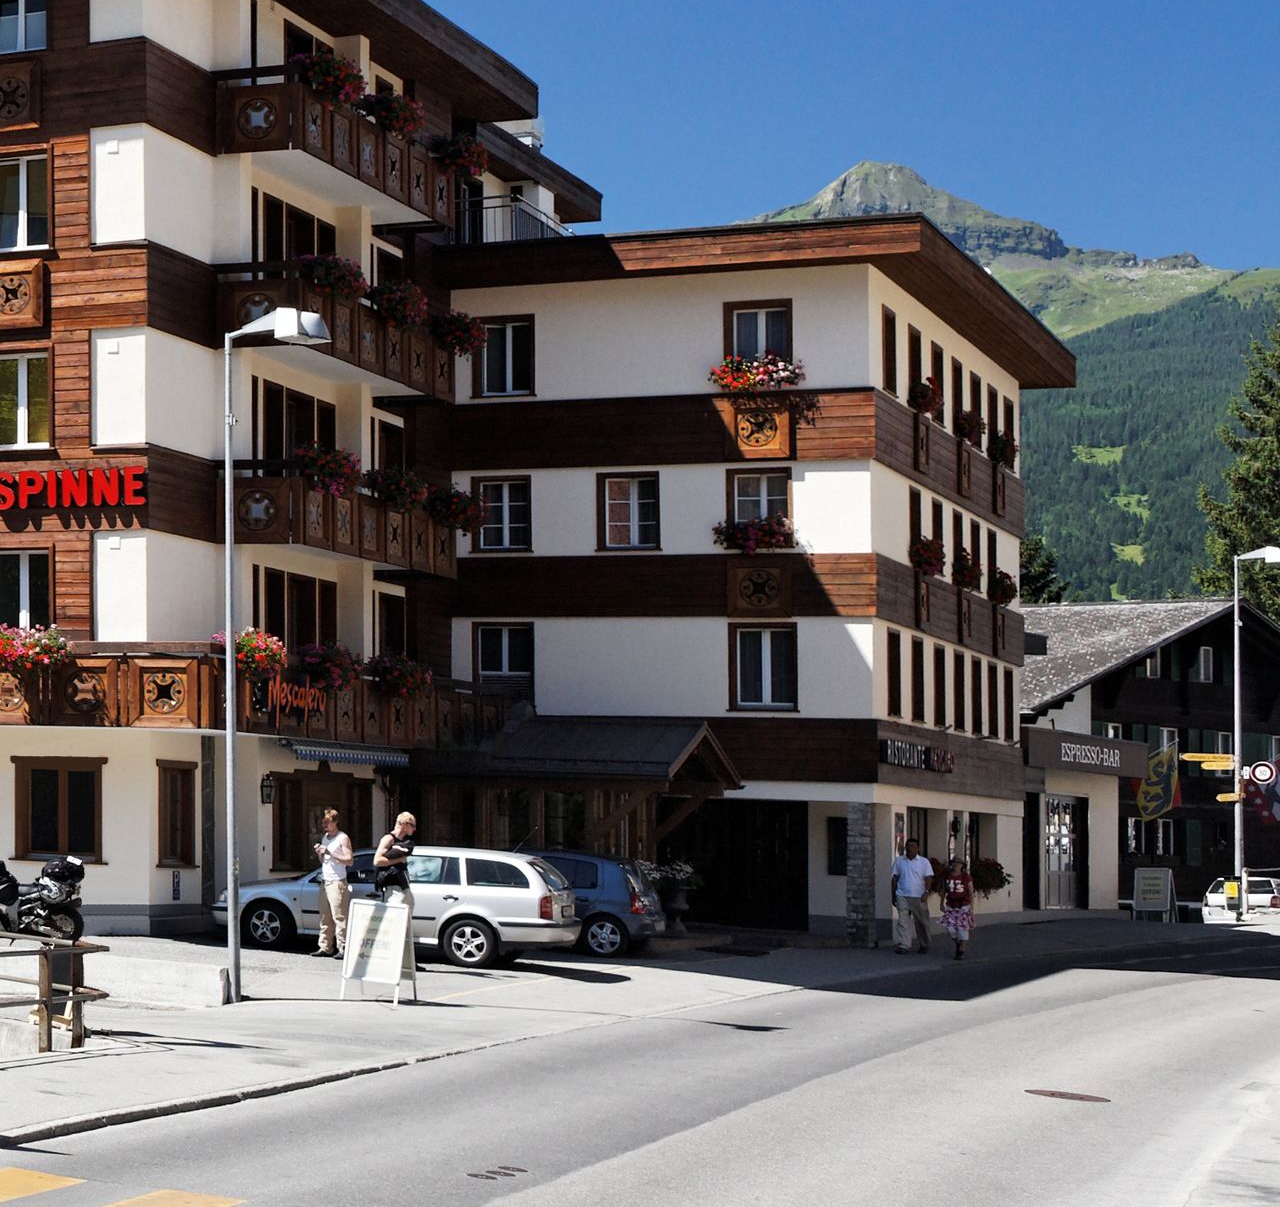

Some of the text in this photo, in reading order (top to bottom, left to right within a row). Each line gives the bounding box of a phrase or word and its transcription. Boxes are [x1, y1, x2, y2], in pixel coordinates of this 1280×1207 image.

[268, 673, 327, 730] Mescalero
[887, 739, 926, 769] RISTORANTE
[1061, 742, 1121, 768] ESPRESSO-BAR
